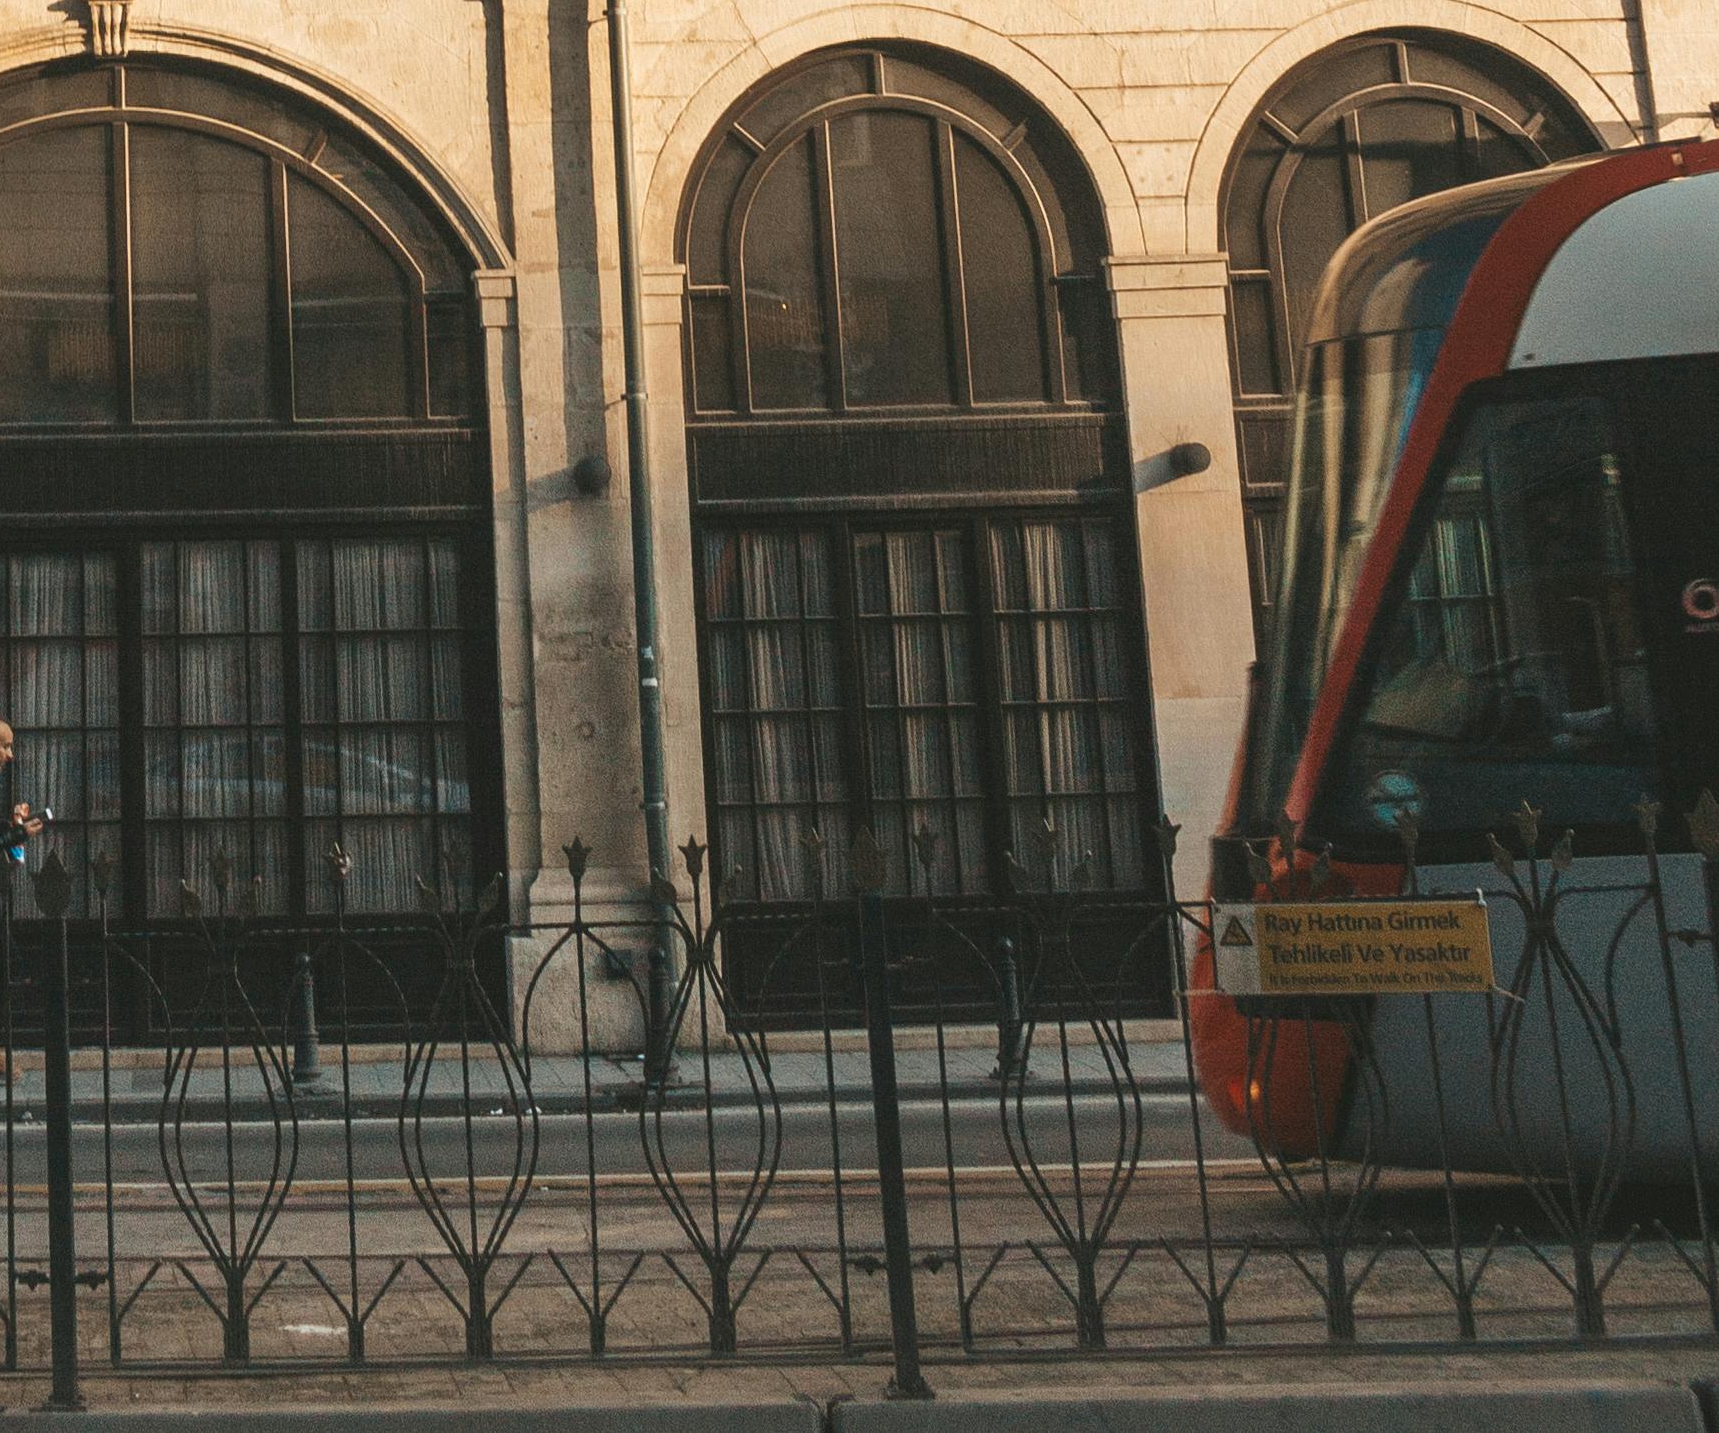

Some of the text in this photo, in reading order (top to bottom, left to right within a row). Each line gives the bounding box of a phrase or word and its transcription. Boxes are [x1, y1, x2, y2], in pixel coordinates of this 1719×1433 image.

[1264, 911, 1461, 935] Ray Hattına Girmek
[1269, 942, 1472, 965] Tehlikeli Ve Yasaktır
[1354, 973, 1369, 984] To
[1370, 973, 1400, 984] Walk
[1403, 973, 1420, 984] On
